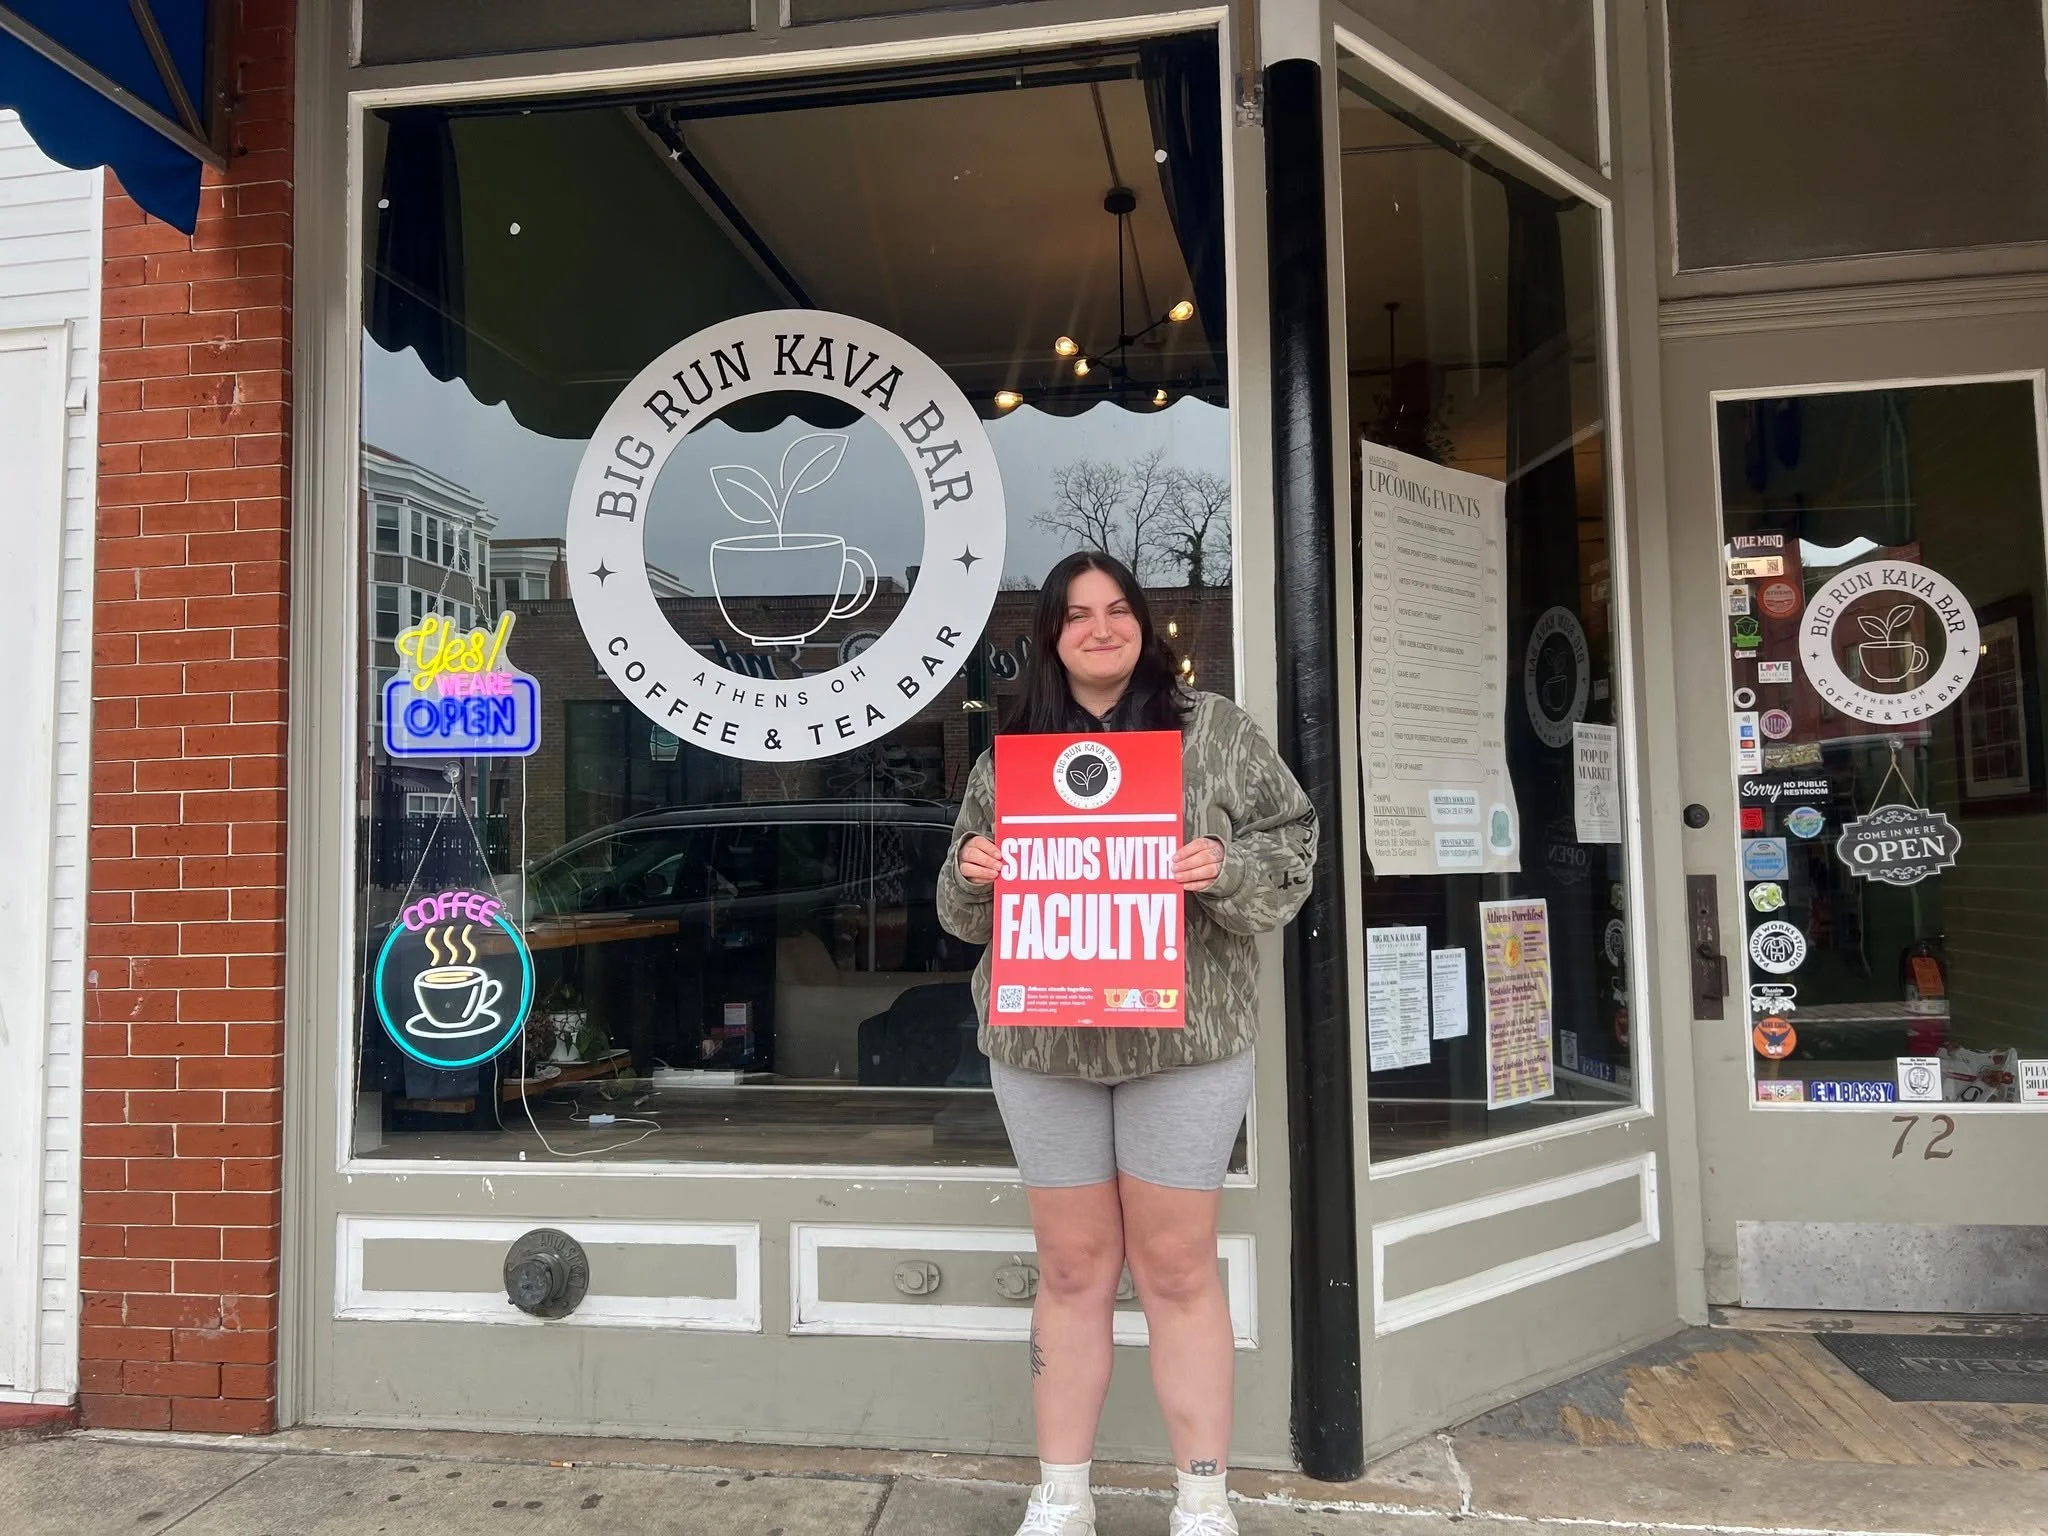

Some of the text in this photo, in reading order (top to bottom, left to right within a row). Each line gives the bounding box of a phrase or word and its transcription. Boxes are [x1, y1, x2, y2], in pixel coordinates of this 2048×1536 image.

[596, 334, 974, 523] BIG RUN KAVA BAR
[1369, 470, 1481, 519] UPCOMING EVENTS
[1732, 535, 1784, 550] VILE MIND
[1811, 569, 1966, 637] BIG RUN KAVA BAR
[608, 636, 738, 745] COFFEE
[764, 728, 783, 750] &
[808, 704, 886, 746] TEA
[897, 624, 962, 700] BAR
[692, 665, 866, 709] ATHENS OH
[1818, 674, 1964, 720] COFFEE & TEA BAR
[1853, 689, 1926, 705] ATHENS OH
[403, 695, 516, 738] OPEN
[1056, 744, 1118, 774] BIG RUN KAVA BAR
[1578, 766, 1611, 781] MARKET
[1741, 780, 1782, 803] Sorry
[1797, 780, 1828, 788] PUBLIC
[1783, 788, 1829, 796] RESTROOM
[1853, 835, 1946, 864] OPEN
[1857, 830, 1888, 841] COME
[1890, 829, 1902, 838] IN
[1001, 836, 1177, 881] STANDS WITH
[402, 891, 501, 932] COFFEE
[1000, 893, 1178, 962] FACULTY!
[1487, 908, 1544, 923] Athens Porchfest
[1752, 924, 1803, 968] PASSION WORKS STUDIO
[1811, 1081, 1895, 1102] EMBASSY
[1892, 1114, 1955, 1161] 72
